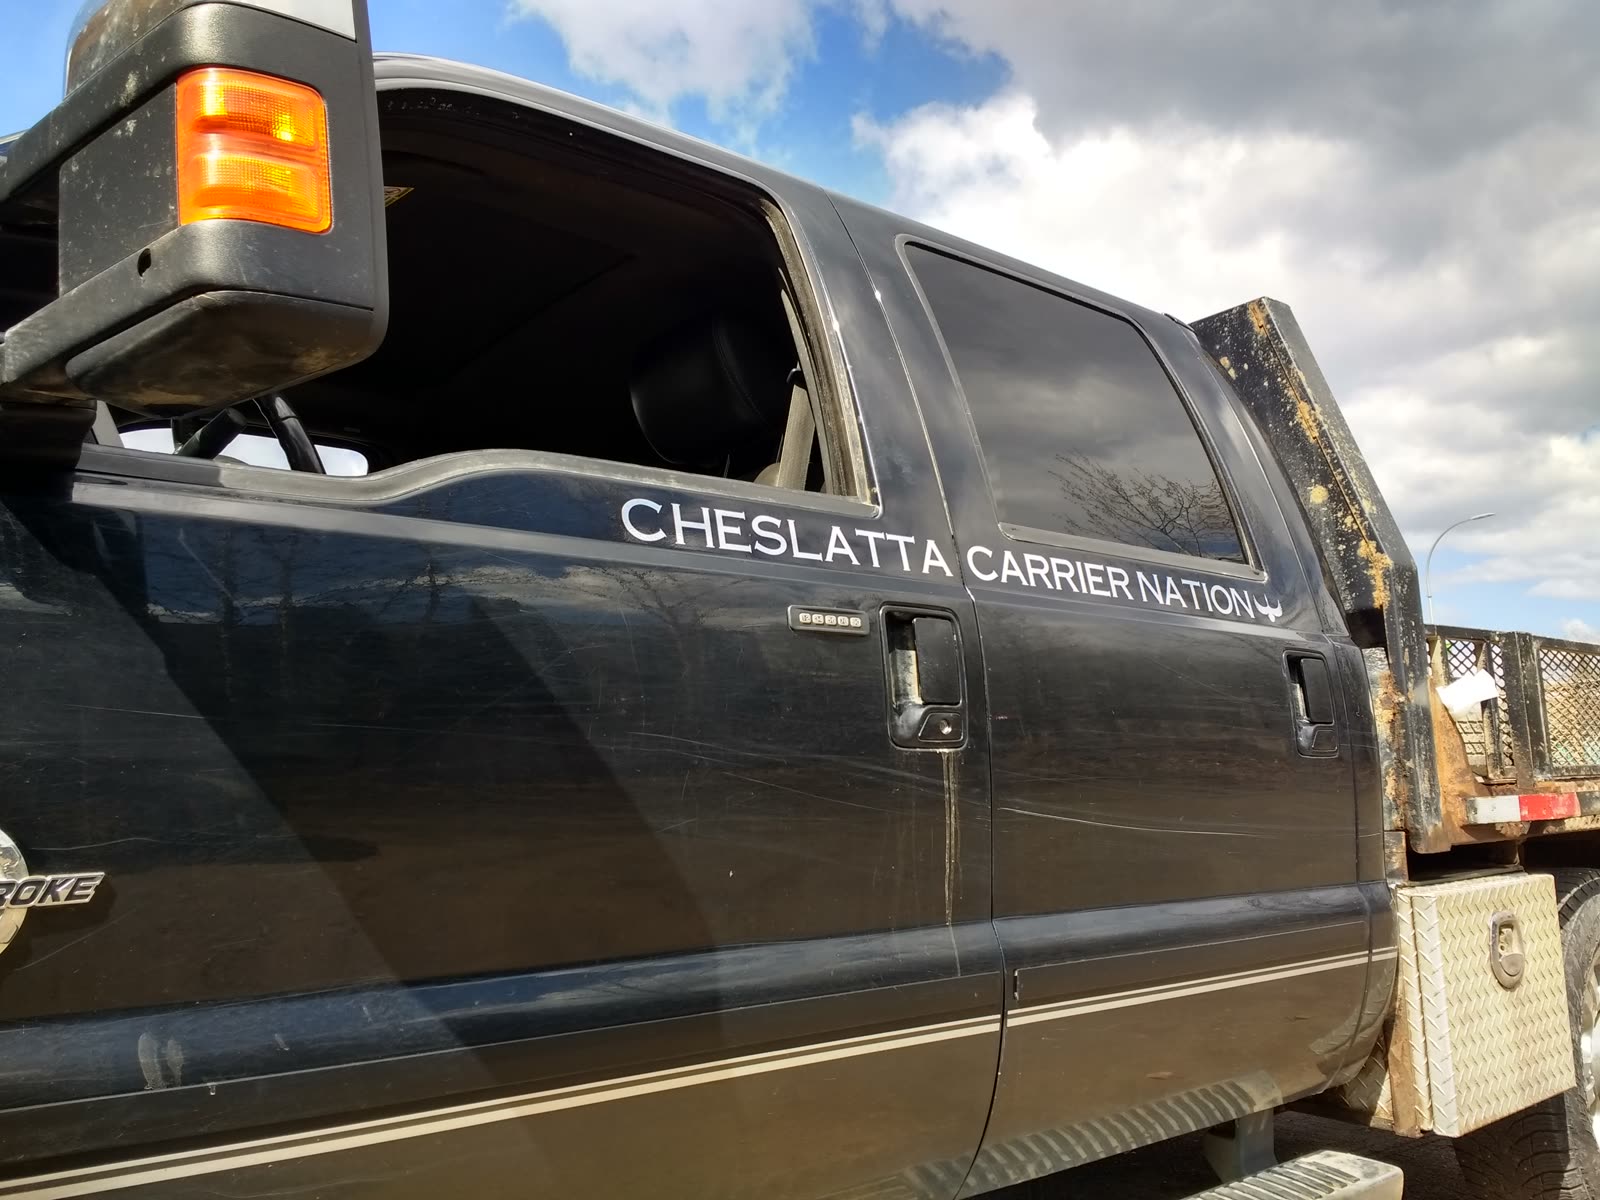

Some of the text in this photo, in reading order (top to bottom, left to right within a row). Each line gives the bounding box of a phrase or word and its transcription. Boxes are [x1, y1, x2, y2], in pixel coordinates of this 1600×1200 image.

[621, 498, 1256, 619] CHESLATTA CARRIER NATION
